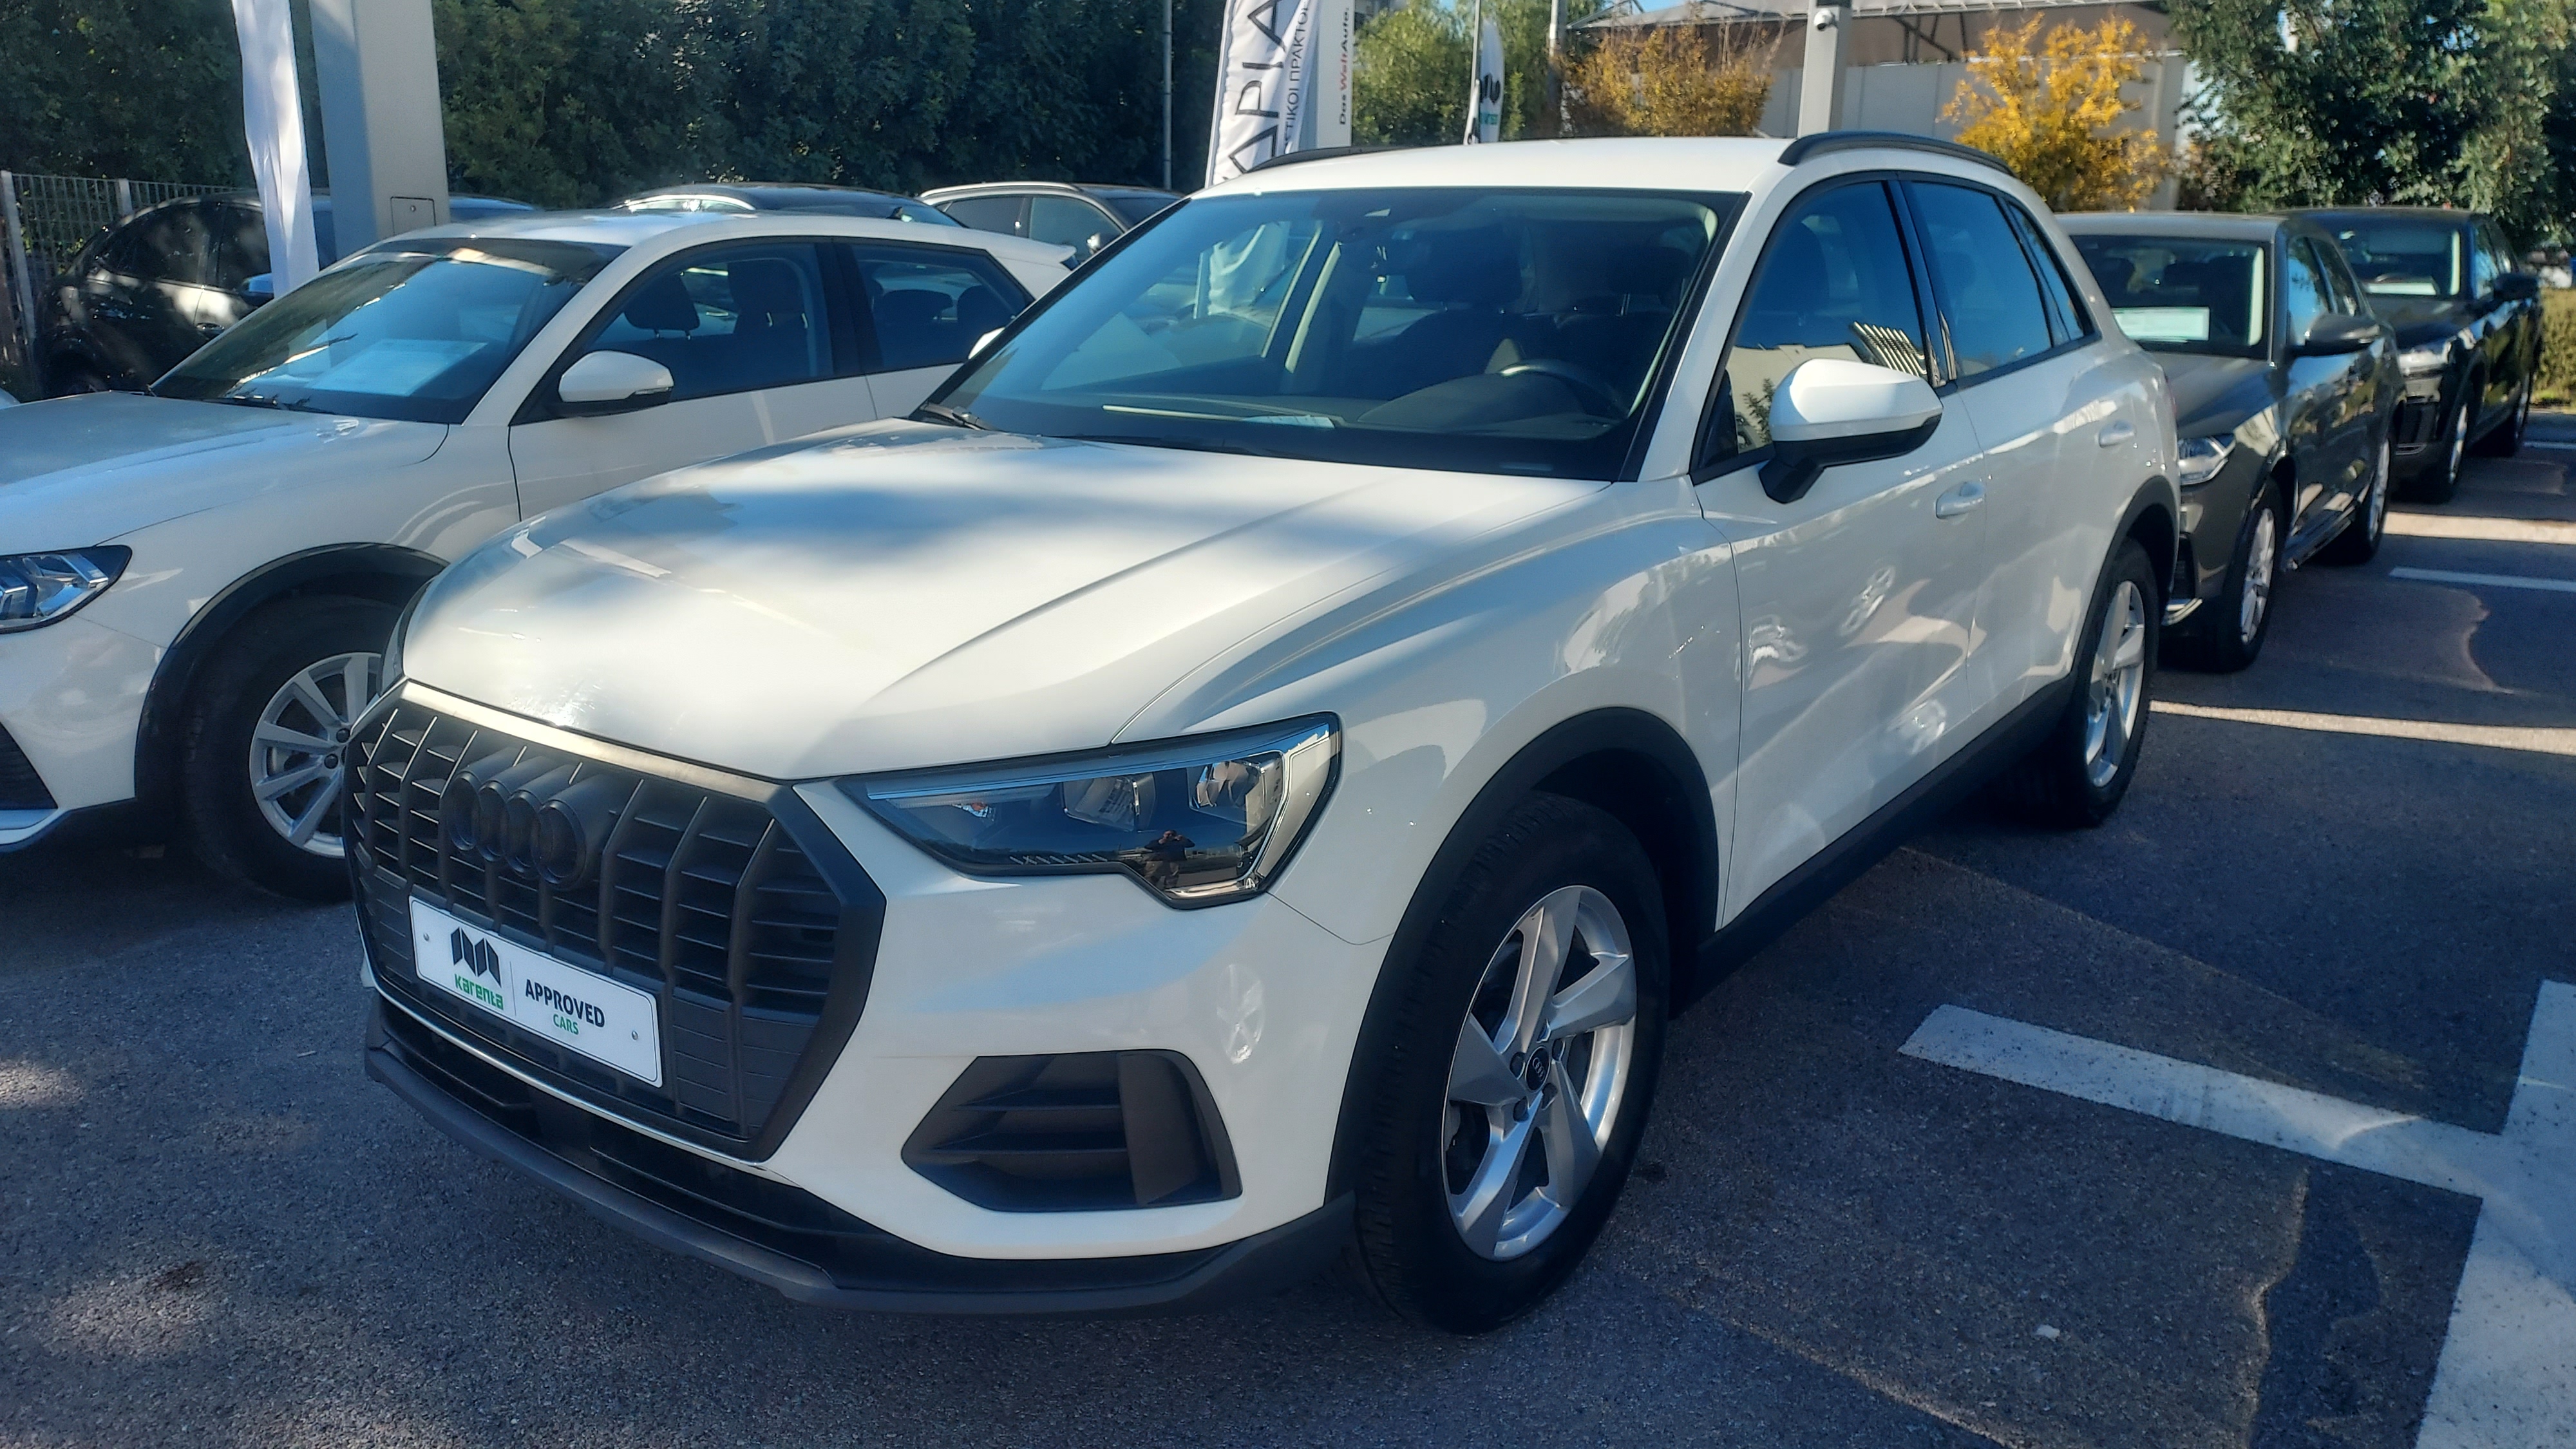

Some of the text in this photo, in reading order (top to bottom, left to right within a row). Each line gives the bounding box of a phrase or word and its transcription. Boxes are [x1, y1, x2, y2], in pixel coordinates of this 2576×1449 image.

[1223, 0, 1286, 180] ΔΡΙΑ
[525, 979, 605, 1028] APPROVED
[553, 1014, 579, 1035] CARS
